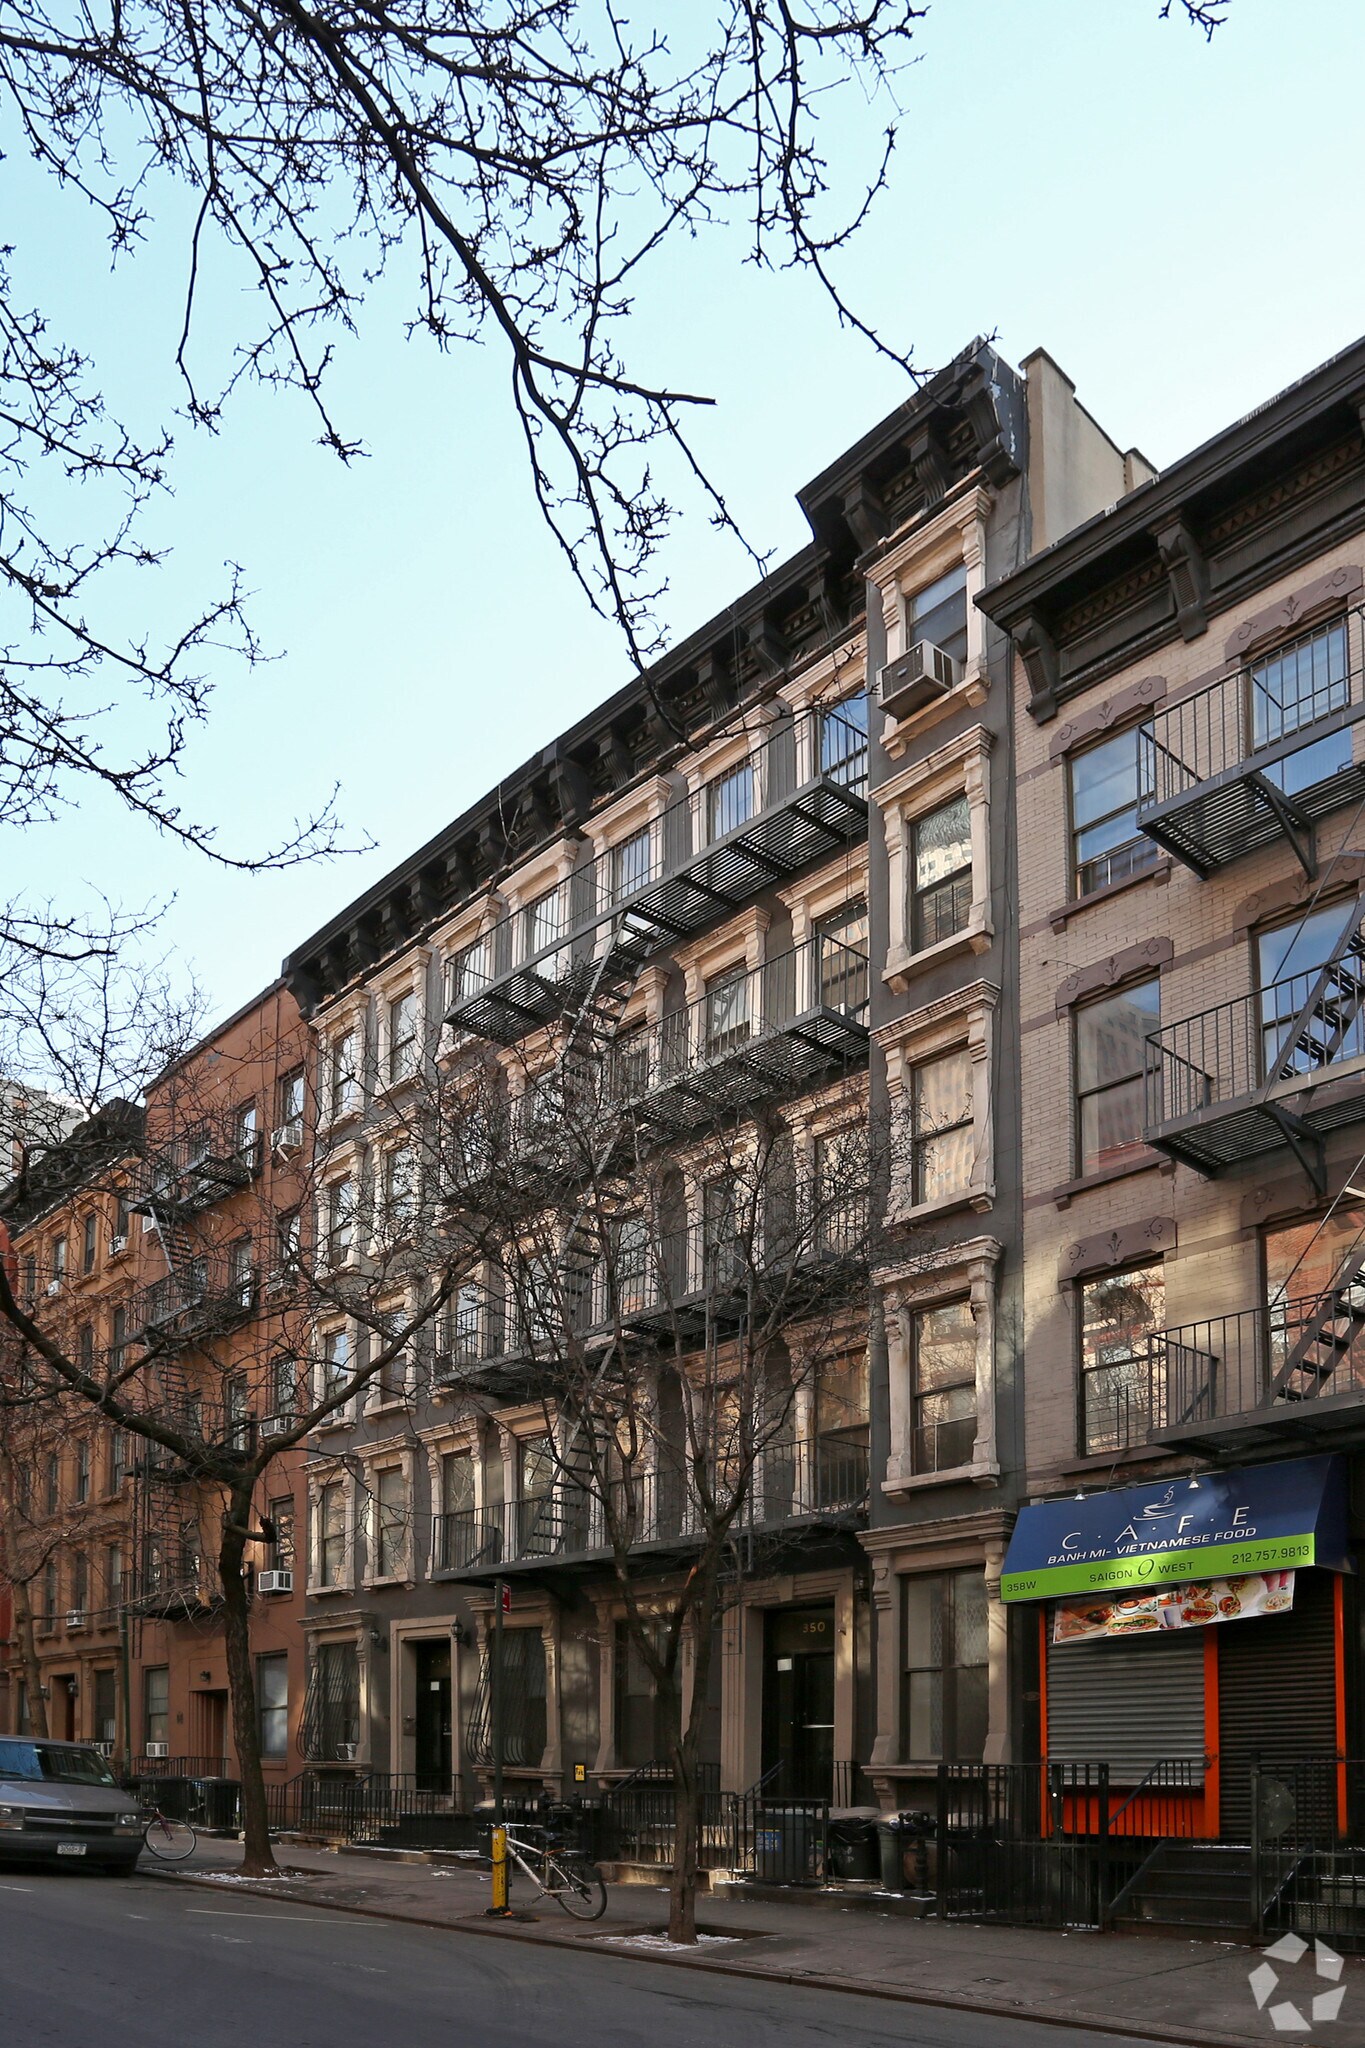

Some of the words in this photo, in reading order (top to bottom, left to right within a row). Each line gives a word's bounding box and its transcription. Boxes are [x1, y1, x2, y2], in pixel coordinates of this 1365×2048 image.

[1047, 1550, 1086, 1564] BANH
[1116, 1533, 1211, 1555] VIETNAMESE
[1214, 1527, 1257, 1541] FOOD
[1232, 1545, 1310, 1564] 212.757.9813
[1089, 1569, 1133, 1583] SAIGON
[1137, 1558, 1155, 1583] 9
[1158, 1561, 1195, 1574] WEST
